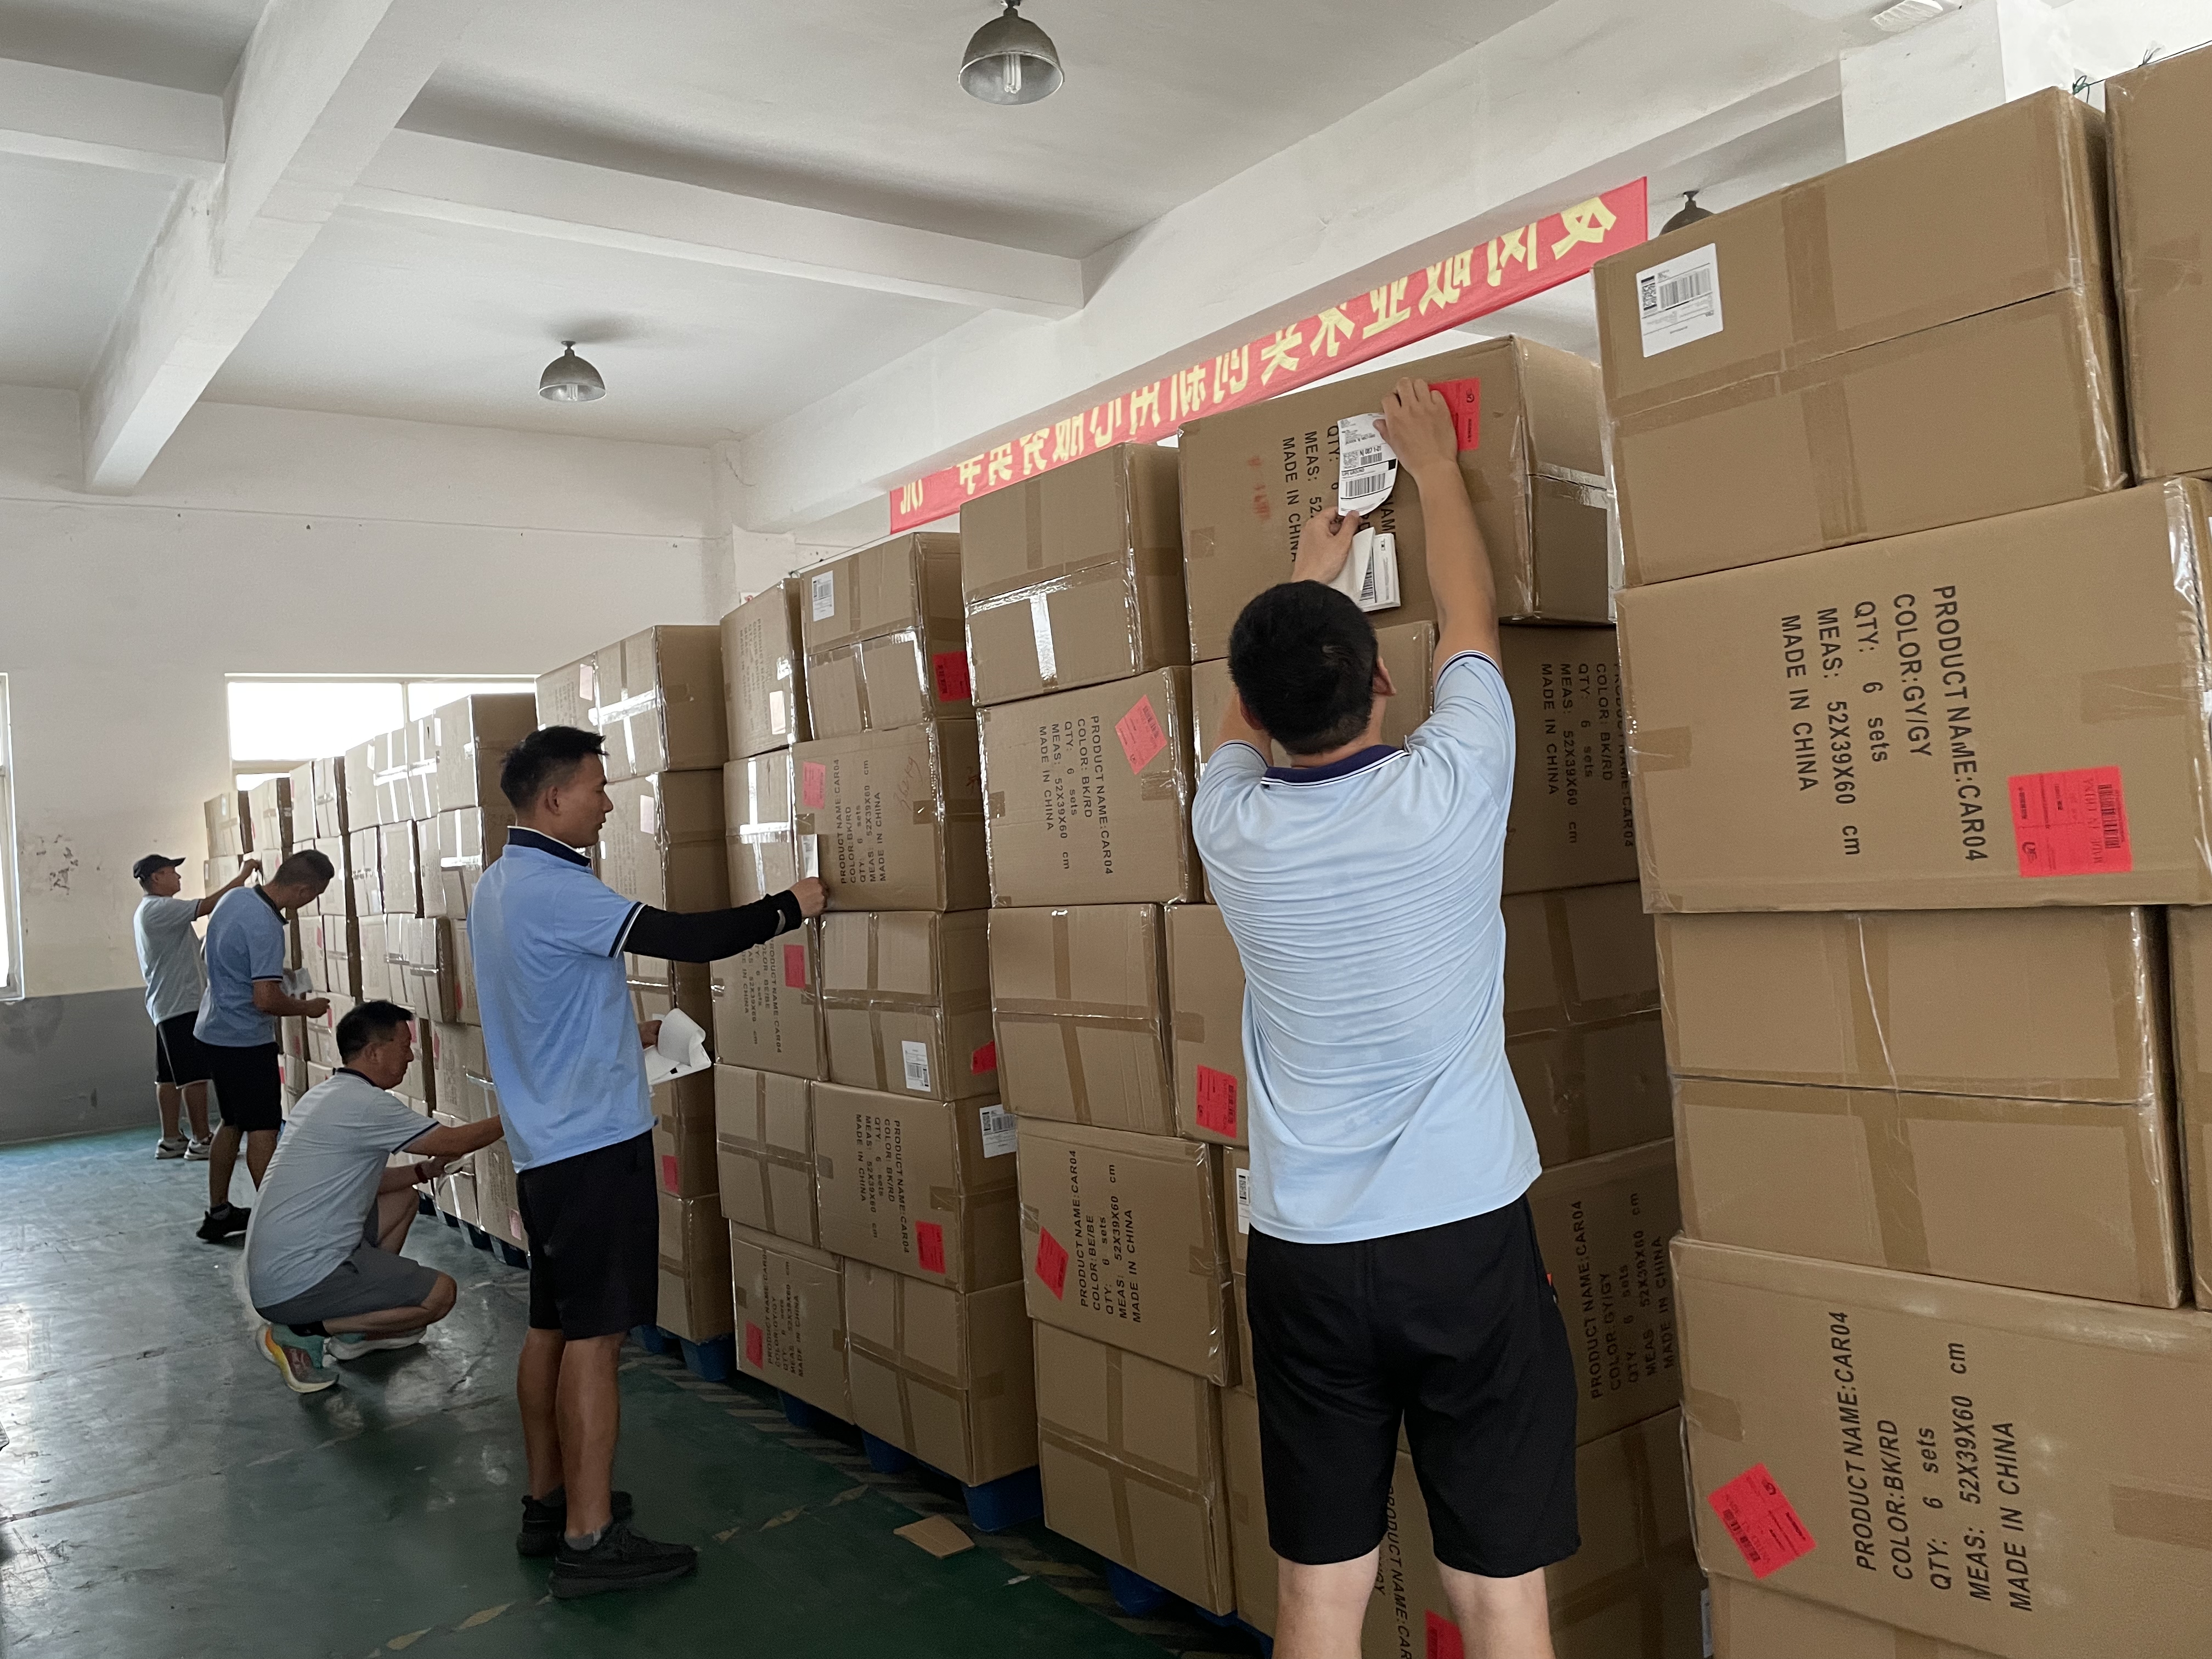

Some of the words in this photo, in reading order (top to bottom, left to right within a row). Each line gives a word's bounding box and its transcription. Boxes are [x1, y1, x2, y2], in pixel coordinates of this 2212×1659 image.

[1282, 437, 1297, 483] MADE
[1305, 431, 1320, 482] MEAS:
[1286, 489, 1299, 505] IN
[1781, 614, 1807, 678] MADE
[1816, 608, 1843, 679] MEAS:
[1854, 601, 1879, 653] QTY:
[1933, 585, 1968, 700] PRODUCT
[1541, 664, 1555, 710] MADE
[1789, 689, 1810, 710] IN
[1863, 682, 1883, 693] 6
[1893, 593, 1932, 757] COLOR:GY/GY
[1039, 726, 1049, 763] MADE
[1051, 724, 1061, 765] MEAS:
[1077, 719, 1088, 771] COLOR:
[1091, 716, 1104, 782] PRODUCT
[1545, 719, 1556, 735] IN
[1827, 701, 1857, 804] 52X39X60
[1867, 718, 1890, 763] sets
[864, 760, 869, 775] cm
[1042, 770, 1051, 782] IN
[1064, 721, 1074, 751] QTY:
[1069, 789, 1078, 816] sets
[1546, 743, 1559, 794] CHINA
[1563, 731, 1577, 805] 52X39X60
[1600, 732, 1613, 781] BK/RD
[1792, 722, 1819, 792] CHINA
[833, 759, 843, 828] NAME:CAR04
[1054, 778, 1068, 838] 52X39X60
[1081, 776, 1092, 817] BK/RD
[1946, 707, 1988, 861] NAME:CAR04
[864, 785, 872, 836] 52X39X60
[1044, 789, 1054, 831] CHINA
[1096, 785, 1113, 874] NAME:CAR04
[1568, 821, 1577, 843] cm
[837, 833, 847, 884] PRODUCT
[877, 833, 883, 844] IN
[1062, 851, 1070, 870] cm
[1842, 825, 1861, 855] cm
[878, 850, 886, 881] MADE
[742, 969, 747, 978] IN
[857, 1151, 863, 1162] IN
[894, 1120, 903, 1176] PRODUCT
[1109, 1164, 1116, 1183] cm
[867, 1161, 877, 1212] 52X39X60
[872, 1223, 878, 1238] cm
[886, 1167, 895, 1202] BK/RD
[1069, 1150, 1083, 1238] NAME:CAR04
[897, 1178, 910, 1253] NAME:CAR04
[1099, 1217, 1108, 1244] sets
[1110, 1195, 1122, 1261] 52X39X60
[1124, 1210, 1135, 1253] CHINA
[1076, 1240, 1088, 1307] PRODUCT
[1128, 1261, 1137, 1275] IN
[1651, 1236, 1667, 1288] CHINA
[1104, 1283, 1114, 1314] QTY:
[1130, 1282, 1141, 1323] MADE
[1658, 1297, 1668, 1313] IN
[1584, 1317, 1604, 1398] PRODUCT
[1660, 1322, 1674, 1369] MADE
[1948, 1342, 1967, 1374] cm
[1829, 1311, 1864, 1457] NAME:CAR04
[1916, 1427, 1939, 1473] sets
[1951, 1395, 1980, 1504] 52X39X60
[1991, 1422, 2020, 1495] CHINA
[1845, 1460, 1877, 1571] PRODUCT
[1877, 1420, 1912, 1580] COLOR:BK/RD
[1922, 1496, 1943, 1509] 6
[2000, 1507, 2024, 1532] IN
[1926, 1538, 1952, 1590] QTY:
[1963, 1526, 1991, 1601] MEAS:
[2004, 1542, 2033, 1612] MADE
